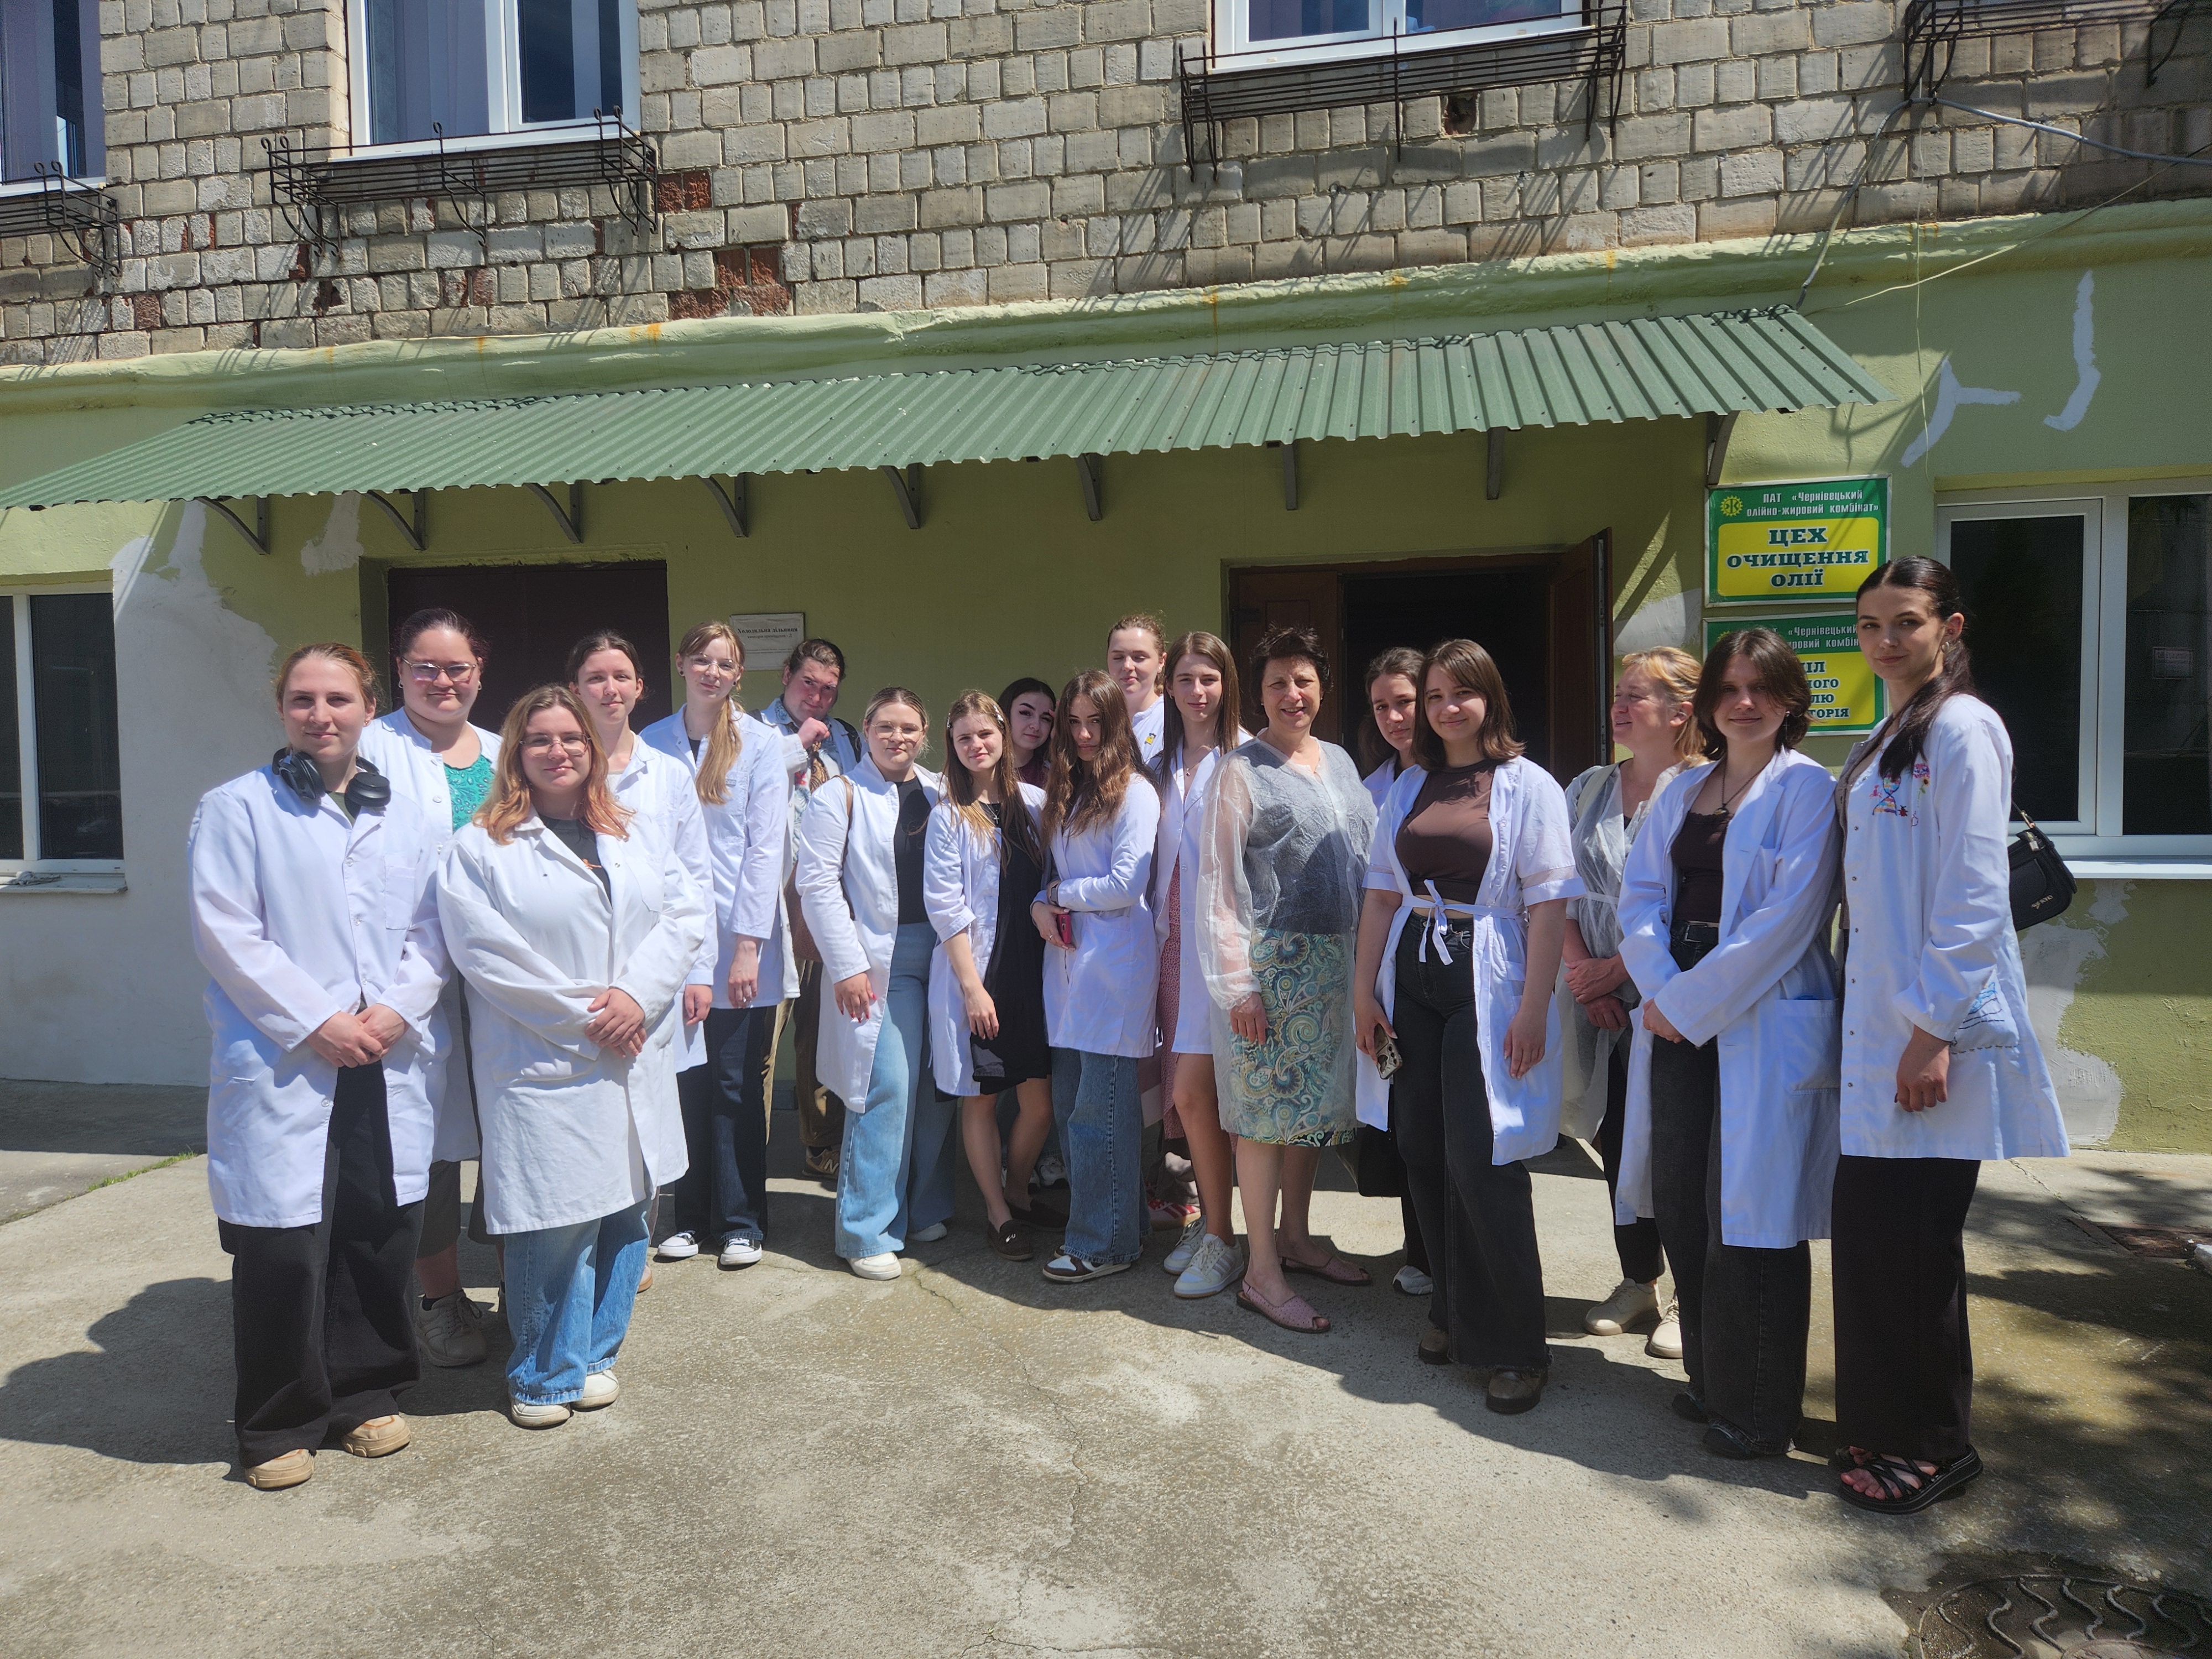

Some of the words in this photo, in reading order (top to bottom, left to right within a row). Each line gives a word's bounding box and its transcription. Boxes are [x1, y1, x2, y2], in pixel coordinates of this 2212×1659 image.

[1763, 493, 1782, 503] ПАТ
[1792, 489, 1863, 503] «Чернівецький
[1746, 503, 1824, 517] олійно-жировий
[1829, 500, 1879, 514] комбінат»
[1768, 526, 1828, 547] ЦЕХ
[1726, 550, 1869, 568] ОЧИЩЕННЯ
[1771, 568, 1824, 587] ОЛІЇ
[1825, 637, 1859, 648] комбін
[1801, 661, 1825, 674] ІЛ
[1811, 693, 1835, 704] ЛЮ
[1808, 708, 1849, 718] ТОРІЯ
